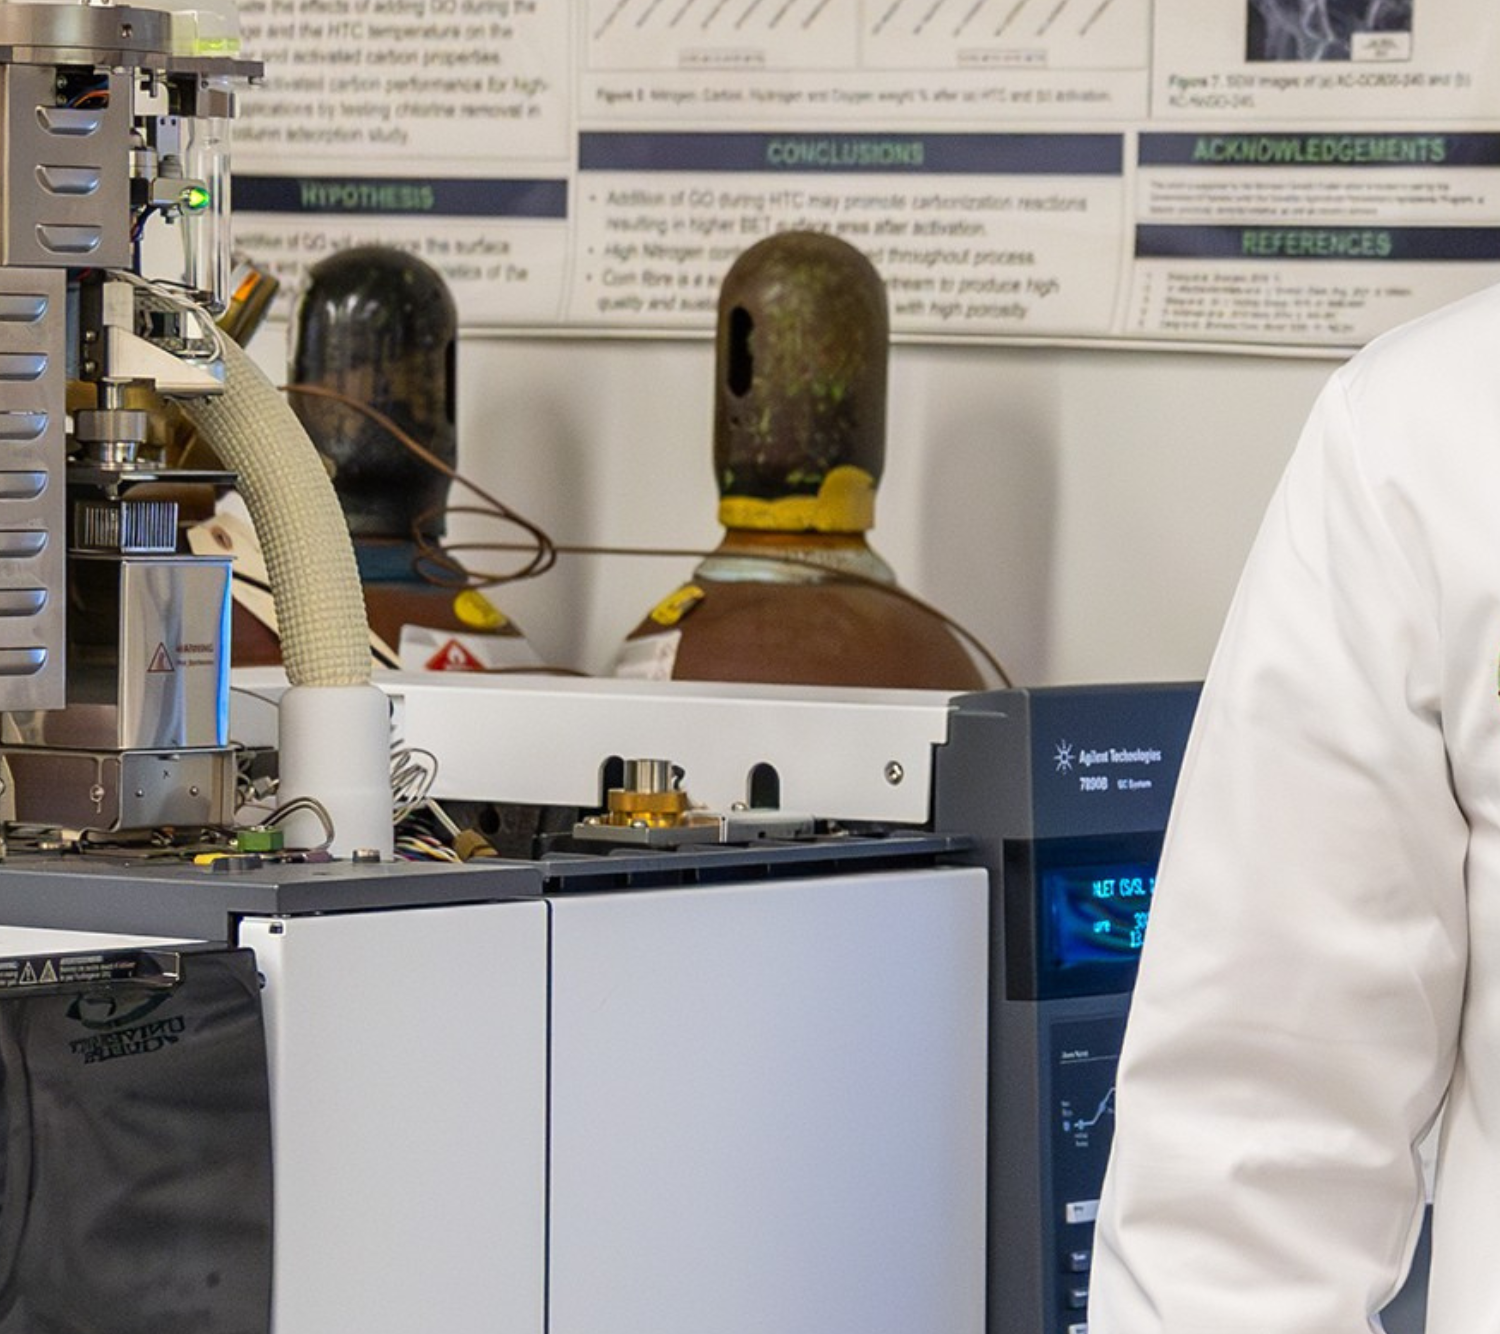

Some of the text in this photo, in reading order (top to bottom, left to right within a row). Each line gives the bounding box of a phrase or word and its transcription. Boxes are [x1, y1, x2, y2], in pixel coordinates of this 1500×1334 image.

[768, 141, 924, 166] CONCLUSIONS
[1194, 138, 1447, 162] ACKNOWLEDGEMENTS
[300, 185, 435, 209] HYPOTHESIS
[1243, 232, 1392, 256] REFERENCES
[1079, 748, 1162, 767] Agilent Technologies
